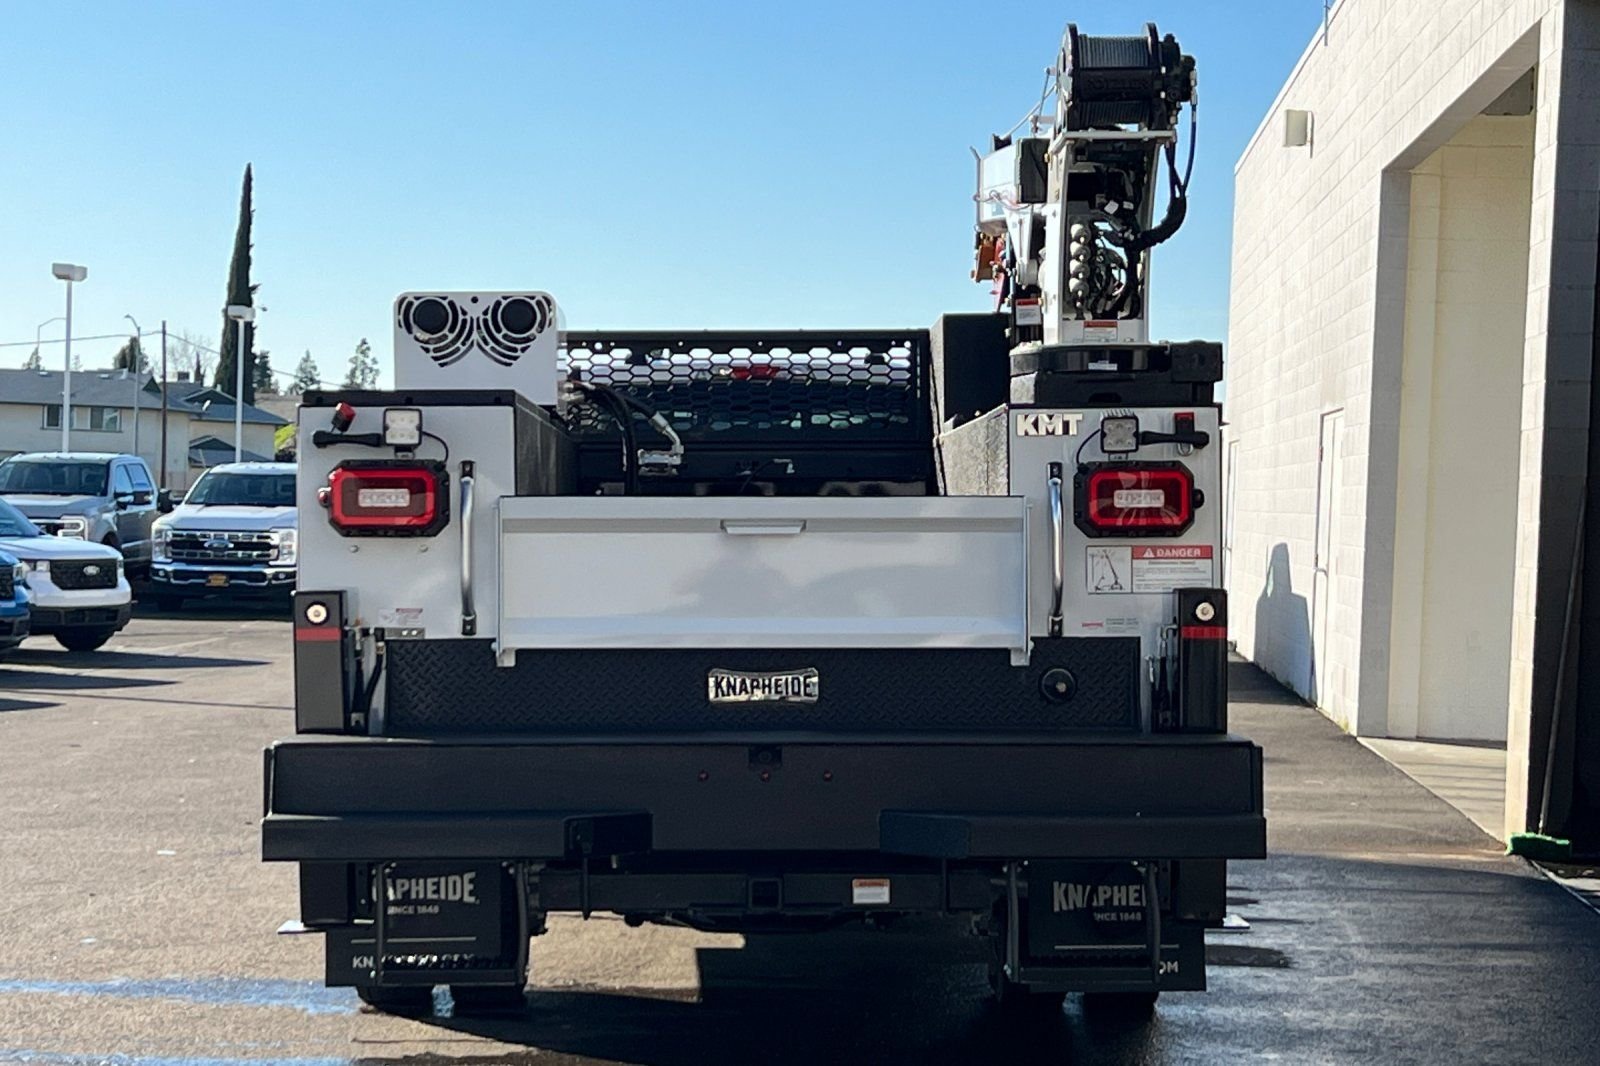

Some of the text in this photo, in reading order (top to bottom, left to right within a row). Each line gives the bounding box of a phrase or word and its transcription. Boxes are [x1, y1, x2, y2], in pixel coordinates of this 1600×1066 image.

[1017, 413, 1083, 436] KMT
[1156, 548, 1201, 558] DANGER
[713, 674, 817, 698] KNAPHEIDE
